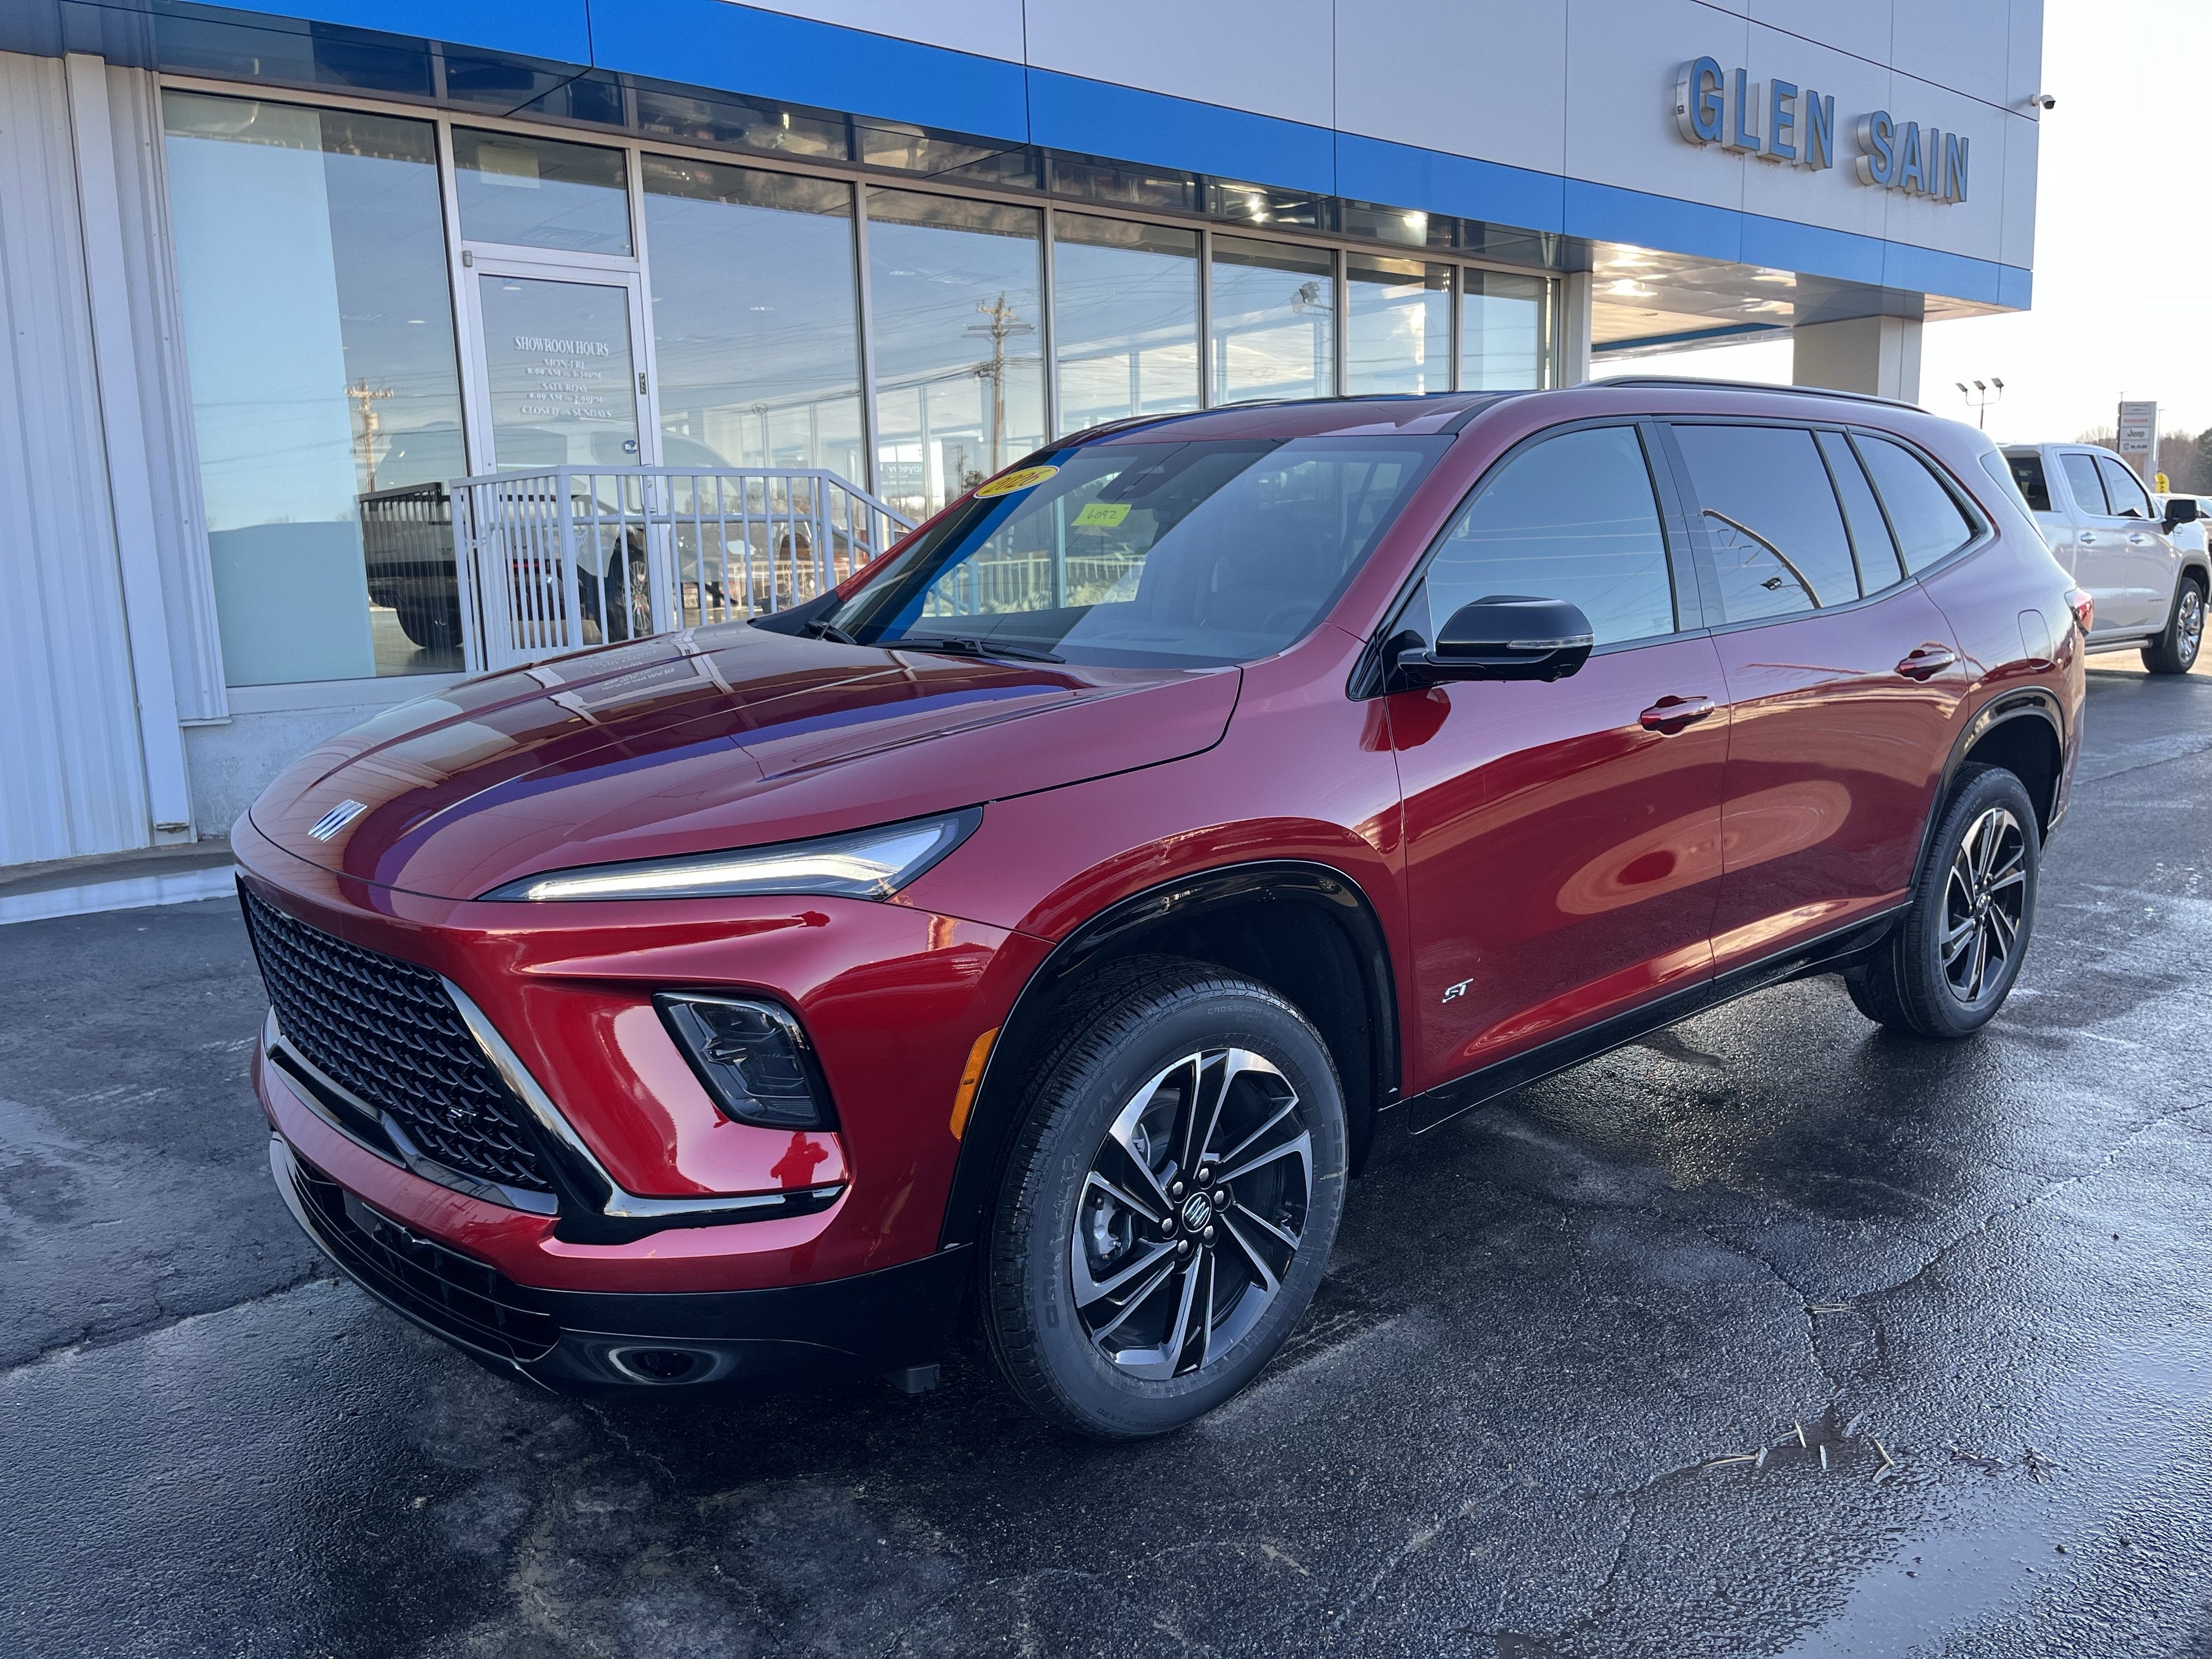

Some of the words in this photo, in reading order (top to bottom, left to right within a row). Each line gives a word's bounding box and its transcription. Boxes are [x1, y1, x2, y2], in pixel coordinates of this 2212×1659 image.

[1680, 56, 1835, 170] GLEN
[1861, 110, 1970, 203] SAIN
[515, 336, 574, 354] SHOWROOM
[576, 341, 609, 357] HOURS
[544, 358, 584, 369] MON-FRI
[543, 382, 588, 393] SATURDAY
[522, 406, 559, 416] CLOSED
[573, 408, 611, 418] SUNDAYS
[2127, 429, 2145, 438] Jeep
[1087, 509, 1118, 520] 6092
[1441, 978, 1474, 1003] ST
[1207, 1005, 1280, 1021] CROSSCONTACT
